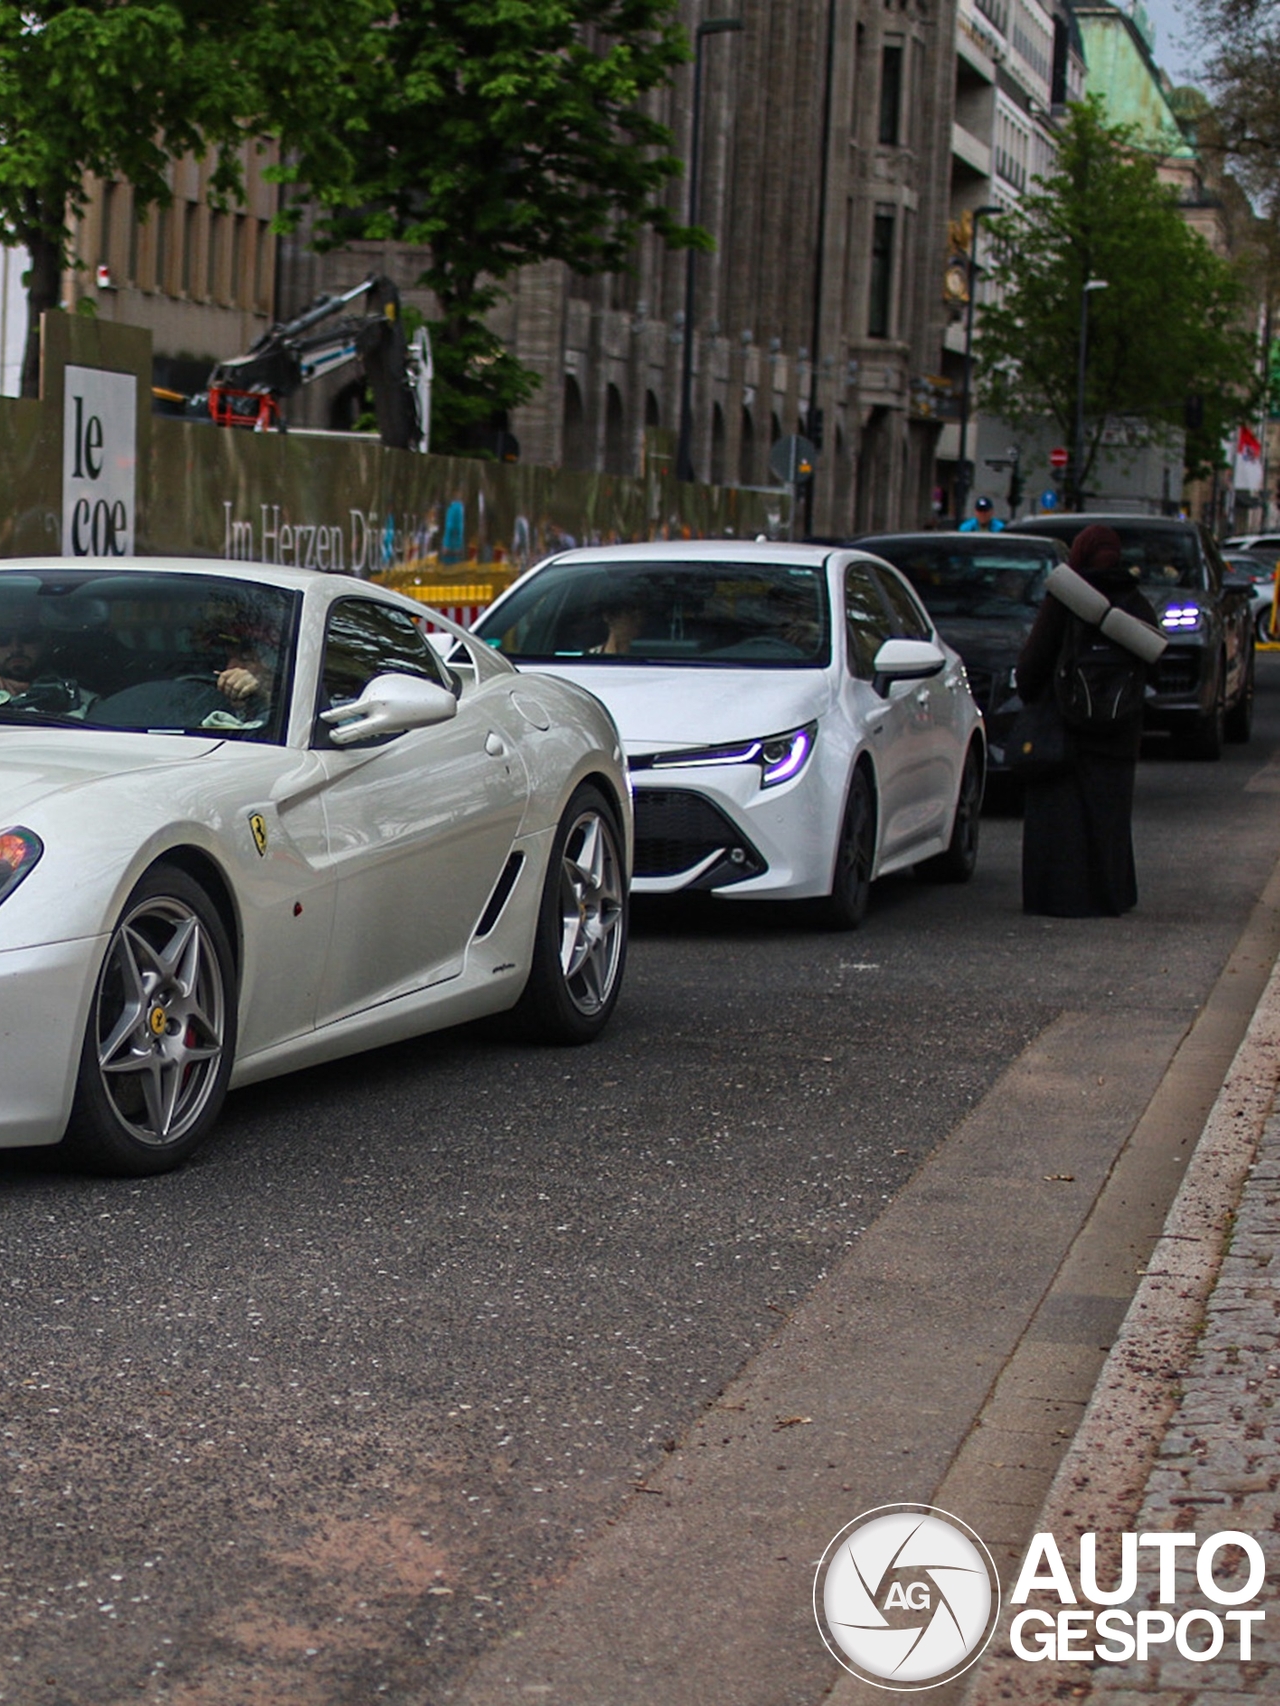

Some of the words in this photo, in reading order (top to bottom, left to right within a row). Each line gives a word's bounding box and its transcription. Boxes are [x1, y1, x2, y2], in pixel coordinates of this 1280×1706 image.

[71, 395, 103, 480] le
[223, 501, 253, 560] Im
[261, 504, 345, 570] Herzen
